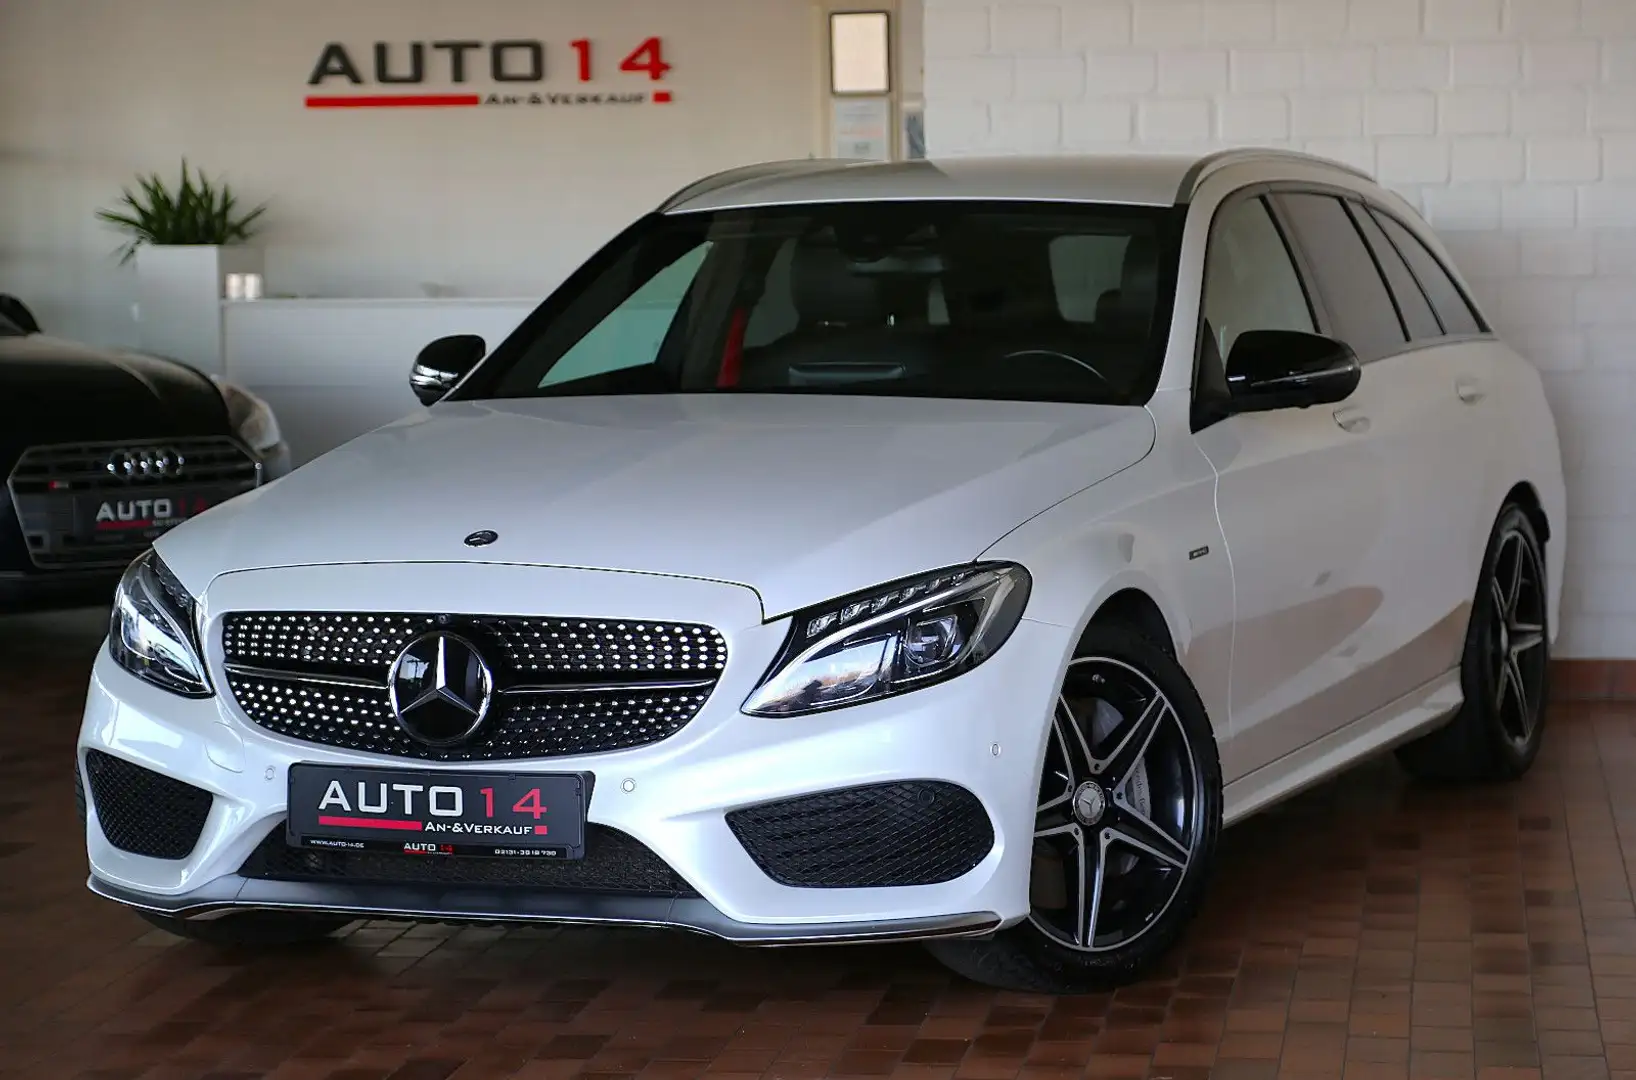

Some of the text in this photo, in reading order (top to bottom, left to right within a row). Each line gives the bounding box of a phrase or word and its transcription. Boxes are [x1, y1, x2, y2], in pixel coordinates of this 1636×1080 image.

[308, 36, 672, 85] AUTO 14
[96, 499, 172, 521] AUTO
[318, 780, 547, 819] AUTO 14
[403, 842, 436, 851] AUTO
